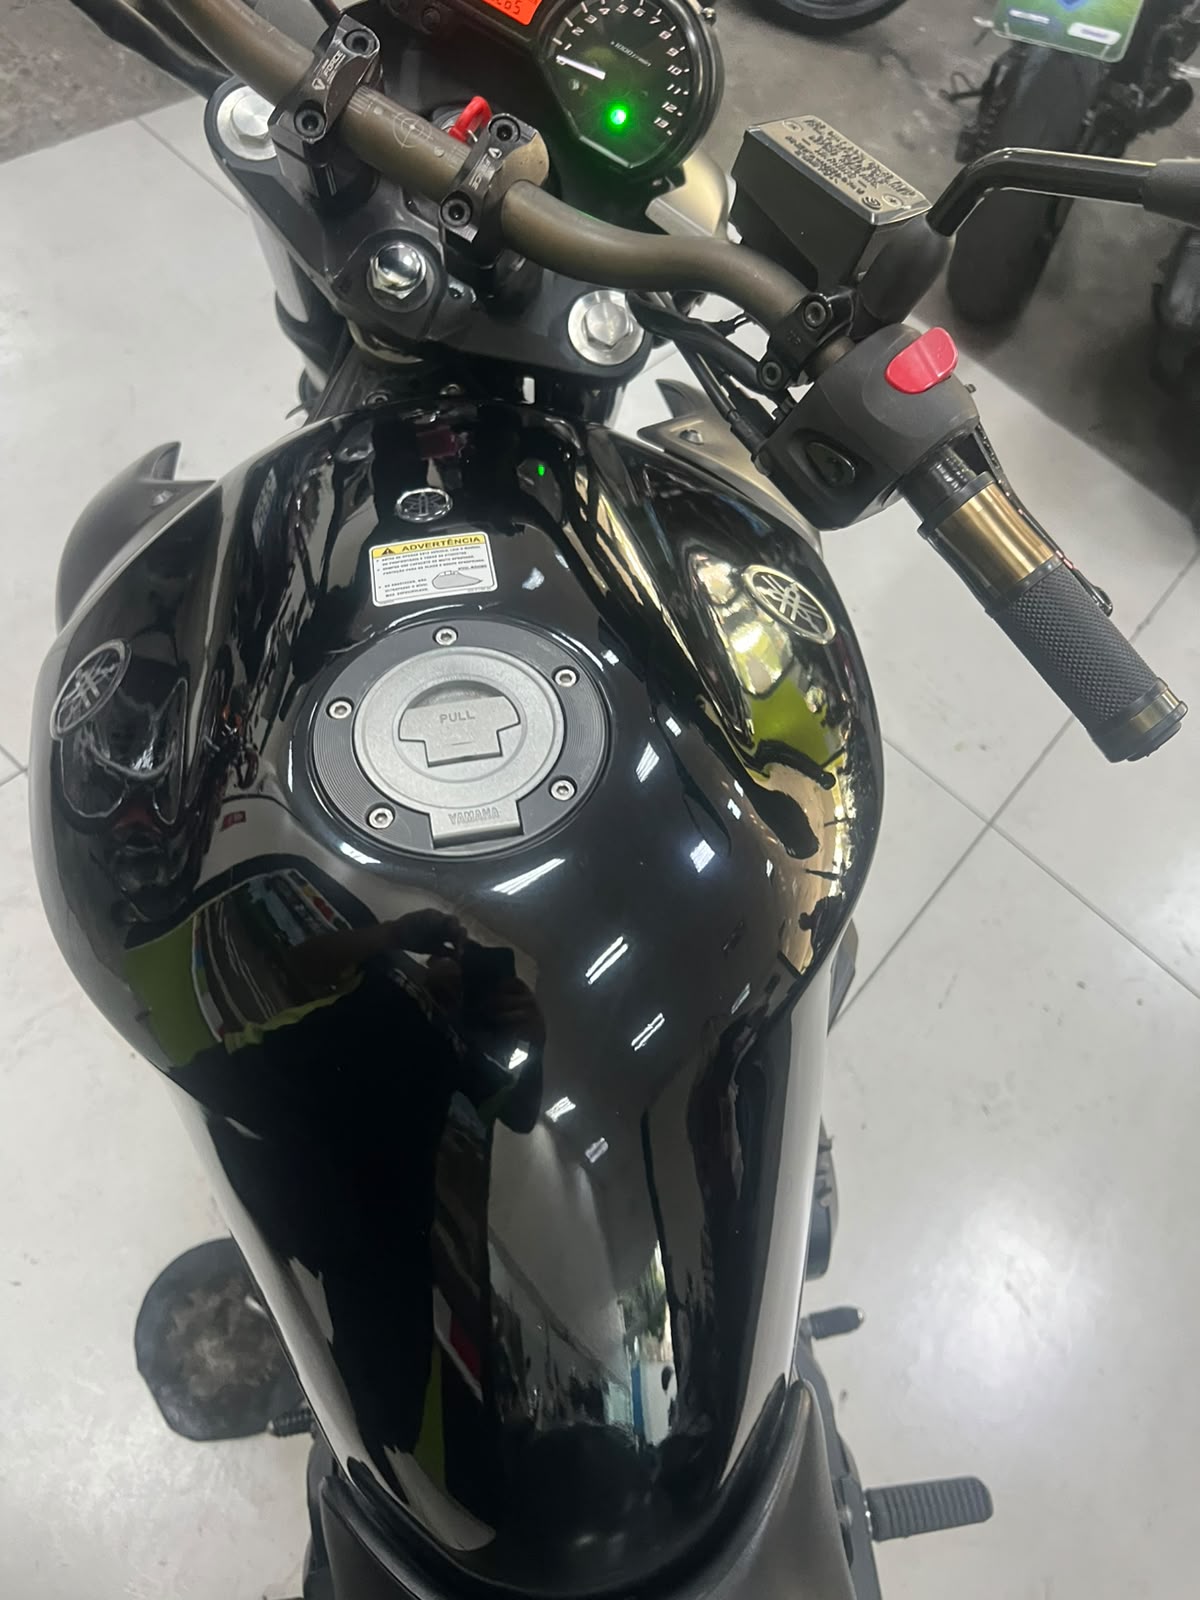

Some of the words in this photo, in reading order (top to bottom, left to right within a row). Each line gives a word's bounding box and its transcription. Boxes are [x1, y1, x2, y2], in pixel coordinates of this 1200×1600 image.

[598, 7, 610, 15] 4
[615, 4, 629, 14] 5
[632, 7, 646, 17] 6
[584, 14, 597, 24] 3
[649, 16, 661, 24] 7
[571, 26, 584, 36] 2
[659, 30, 672, 40] 8
[666, 47, 679, 57] 9
[667, 64, 682, 75] 10
[666, 83, 681, 95] 11
[661, 101, 677, 113] 12
[653, 117, 669, 128] 13
[401, 536, 481, 552] ADVERTÊNCIA
[439, 710, 476, 724] PULL
[447, 806, 500, 825] YAMAHA
